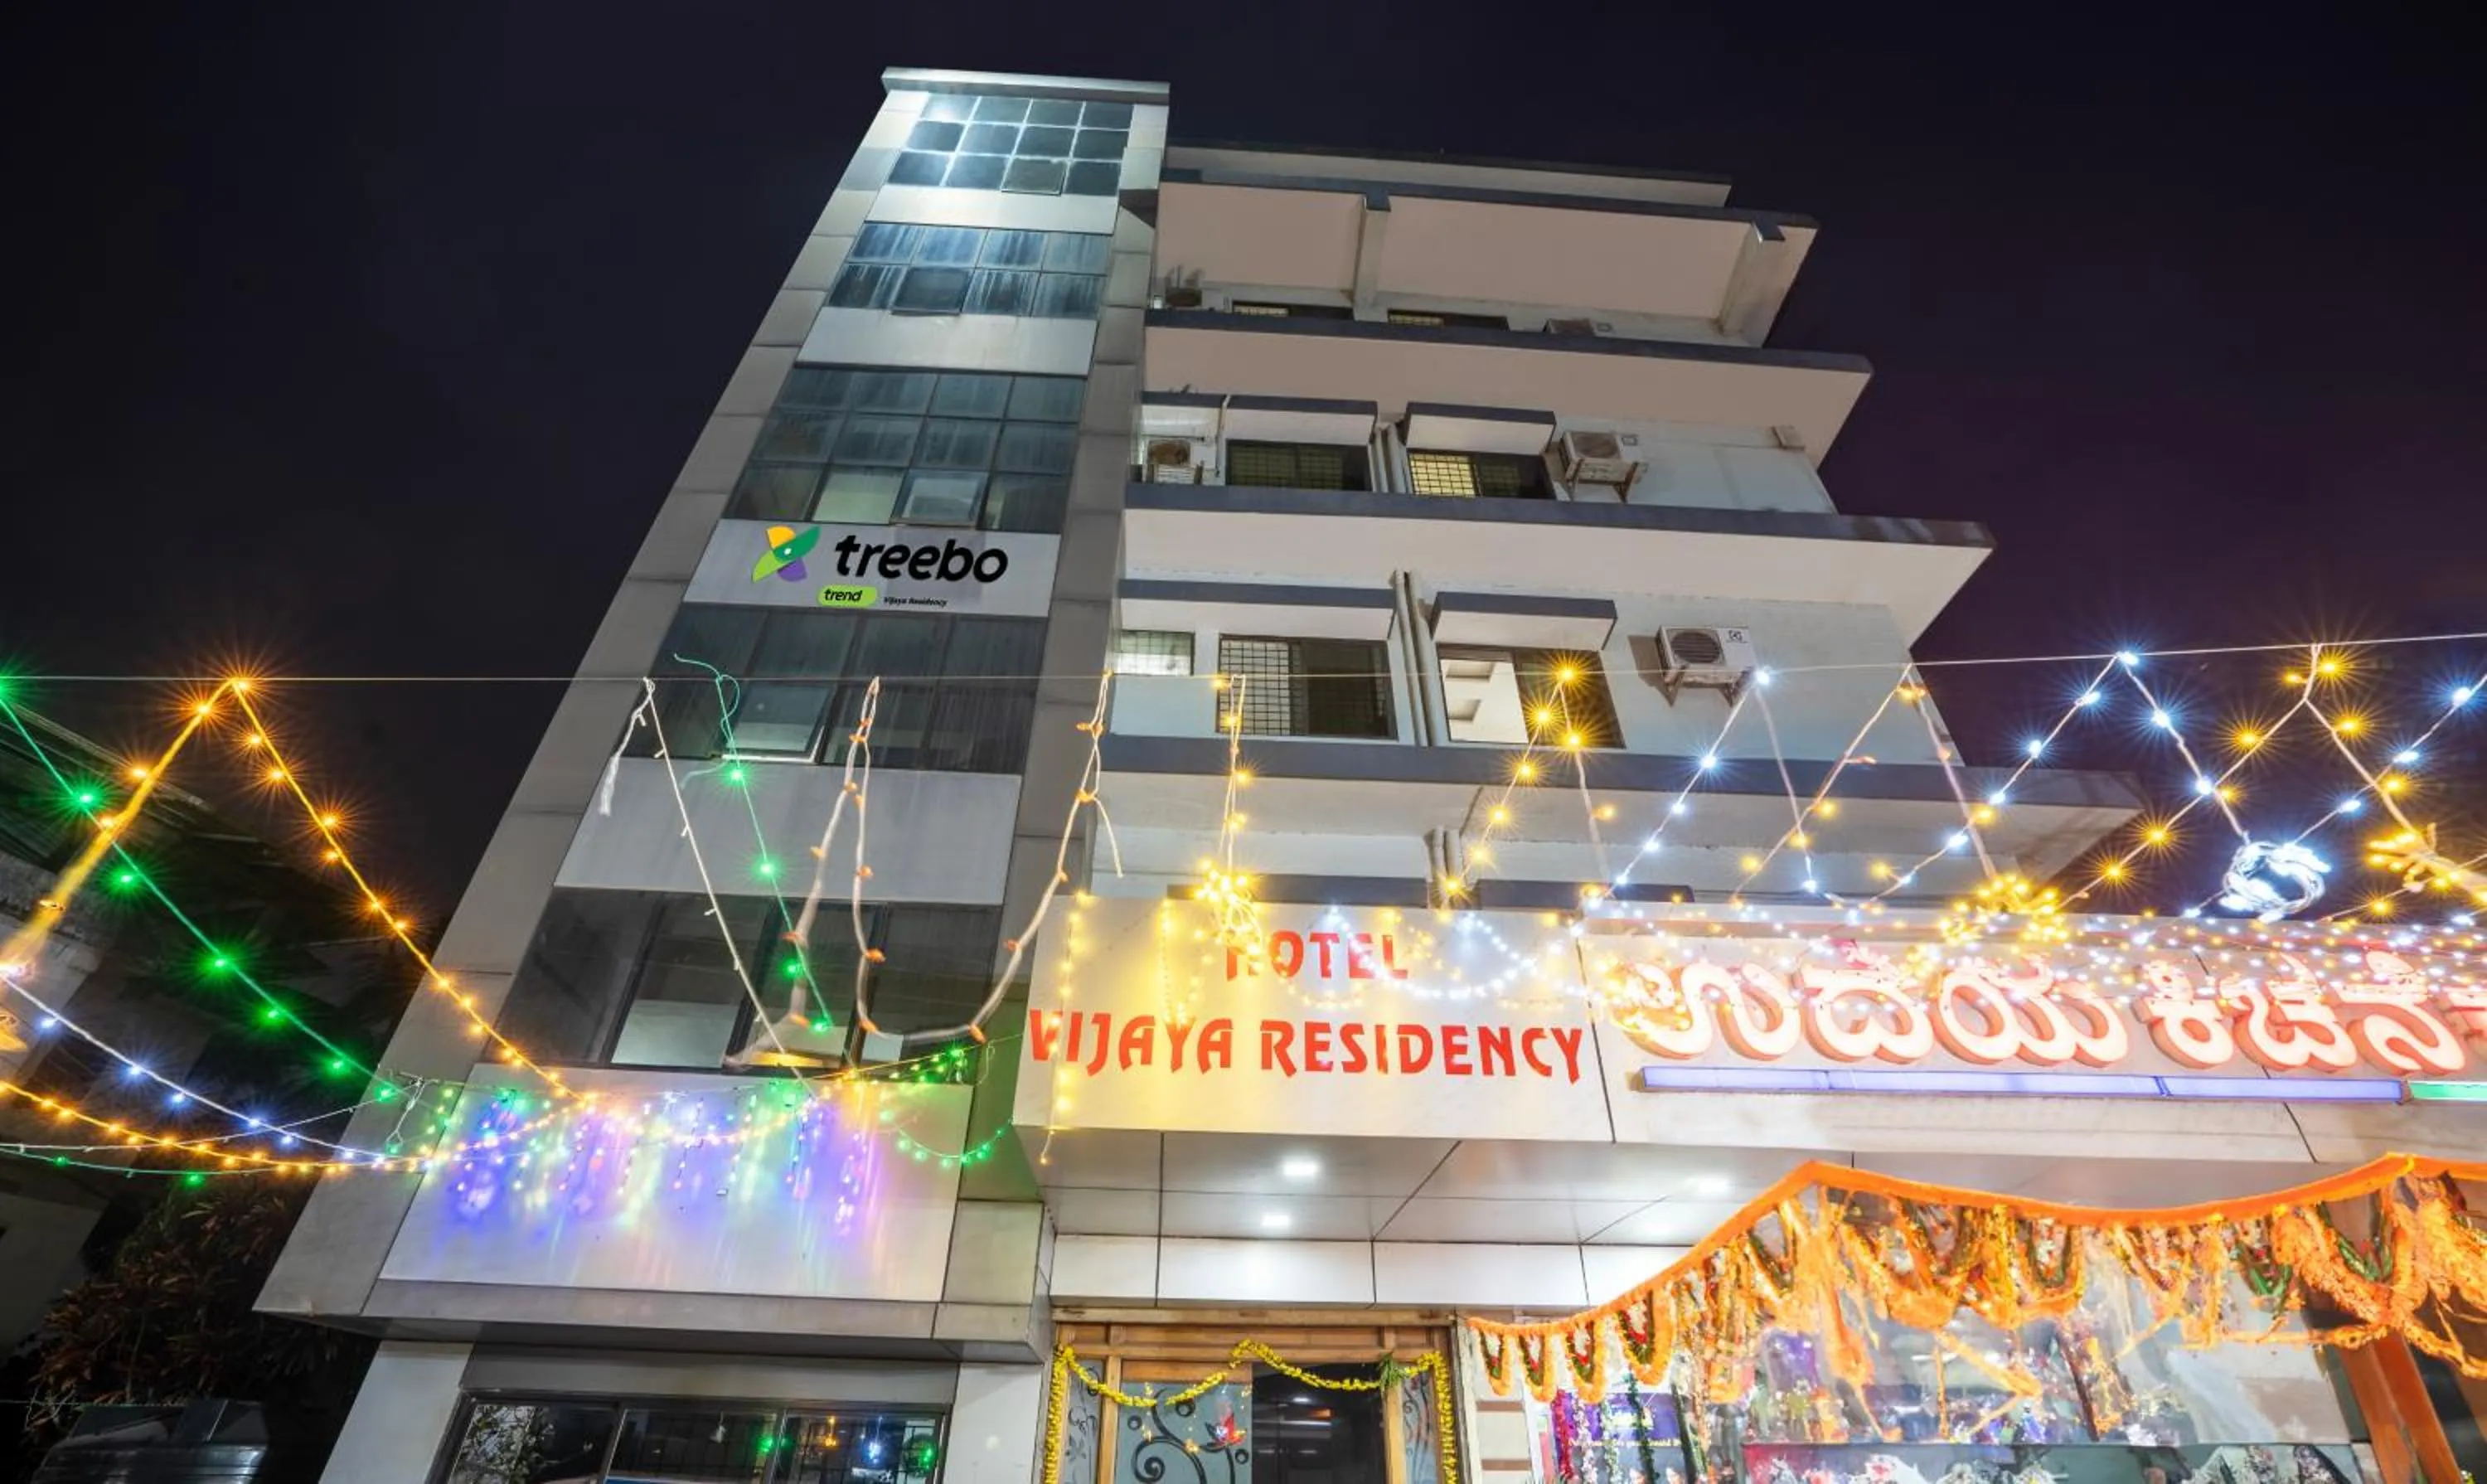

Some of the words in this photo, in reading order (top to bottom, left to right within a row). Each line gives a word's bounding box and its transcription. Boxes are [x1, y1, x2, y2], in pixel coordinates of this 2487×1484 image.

[834, 534, 1009, 583] treebo
[824, 588, 863, 602] trend
[1029, 1008, 1234, 1075] VIJAYA
[1260, 1020, 1583, 1084] RESIDENCY
